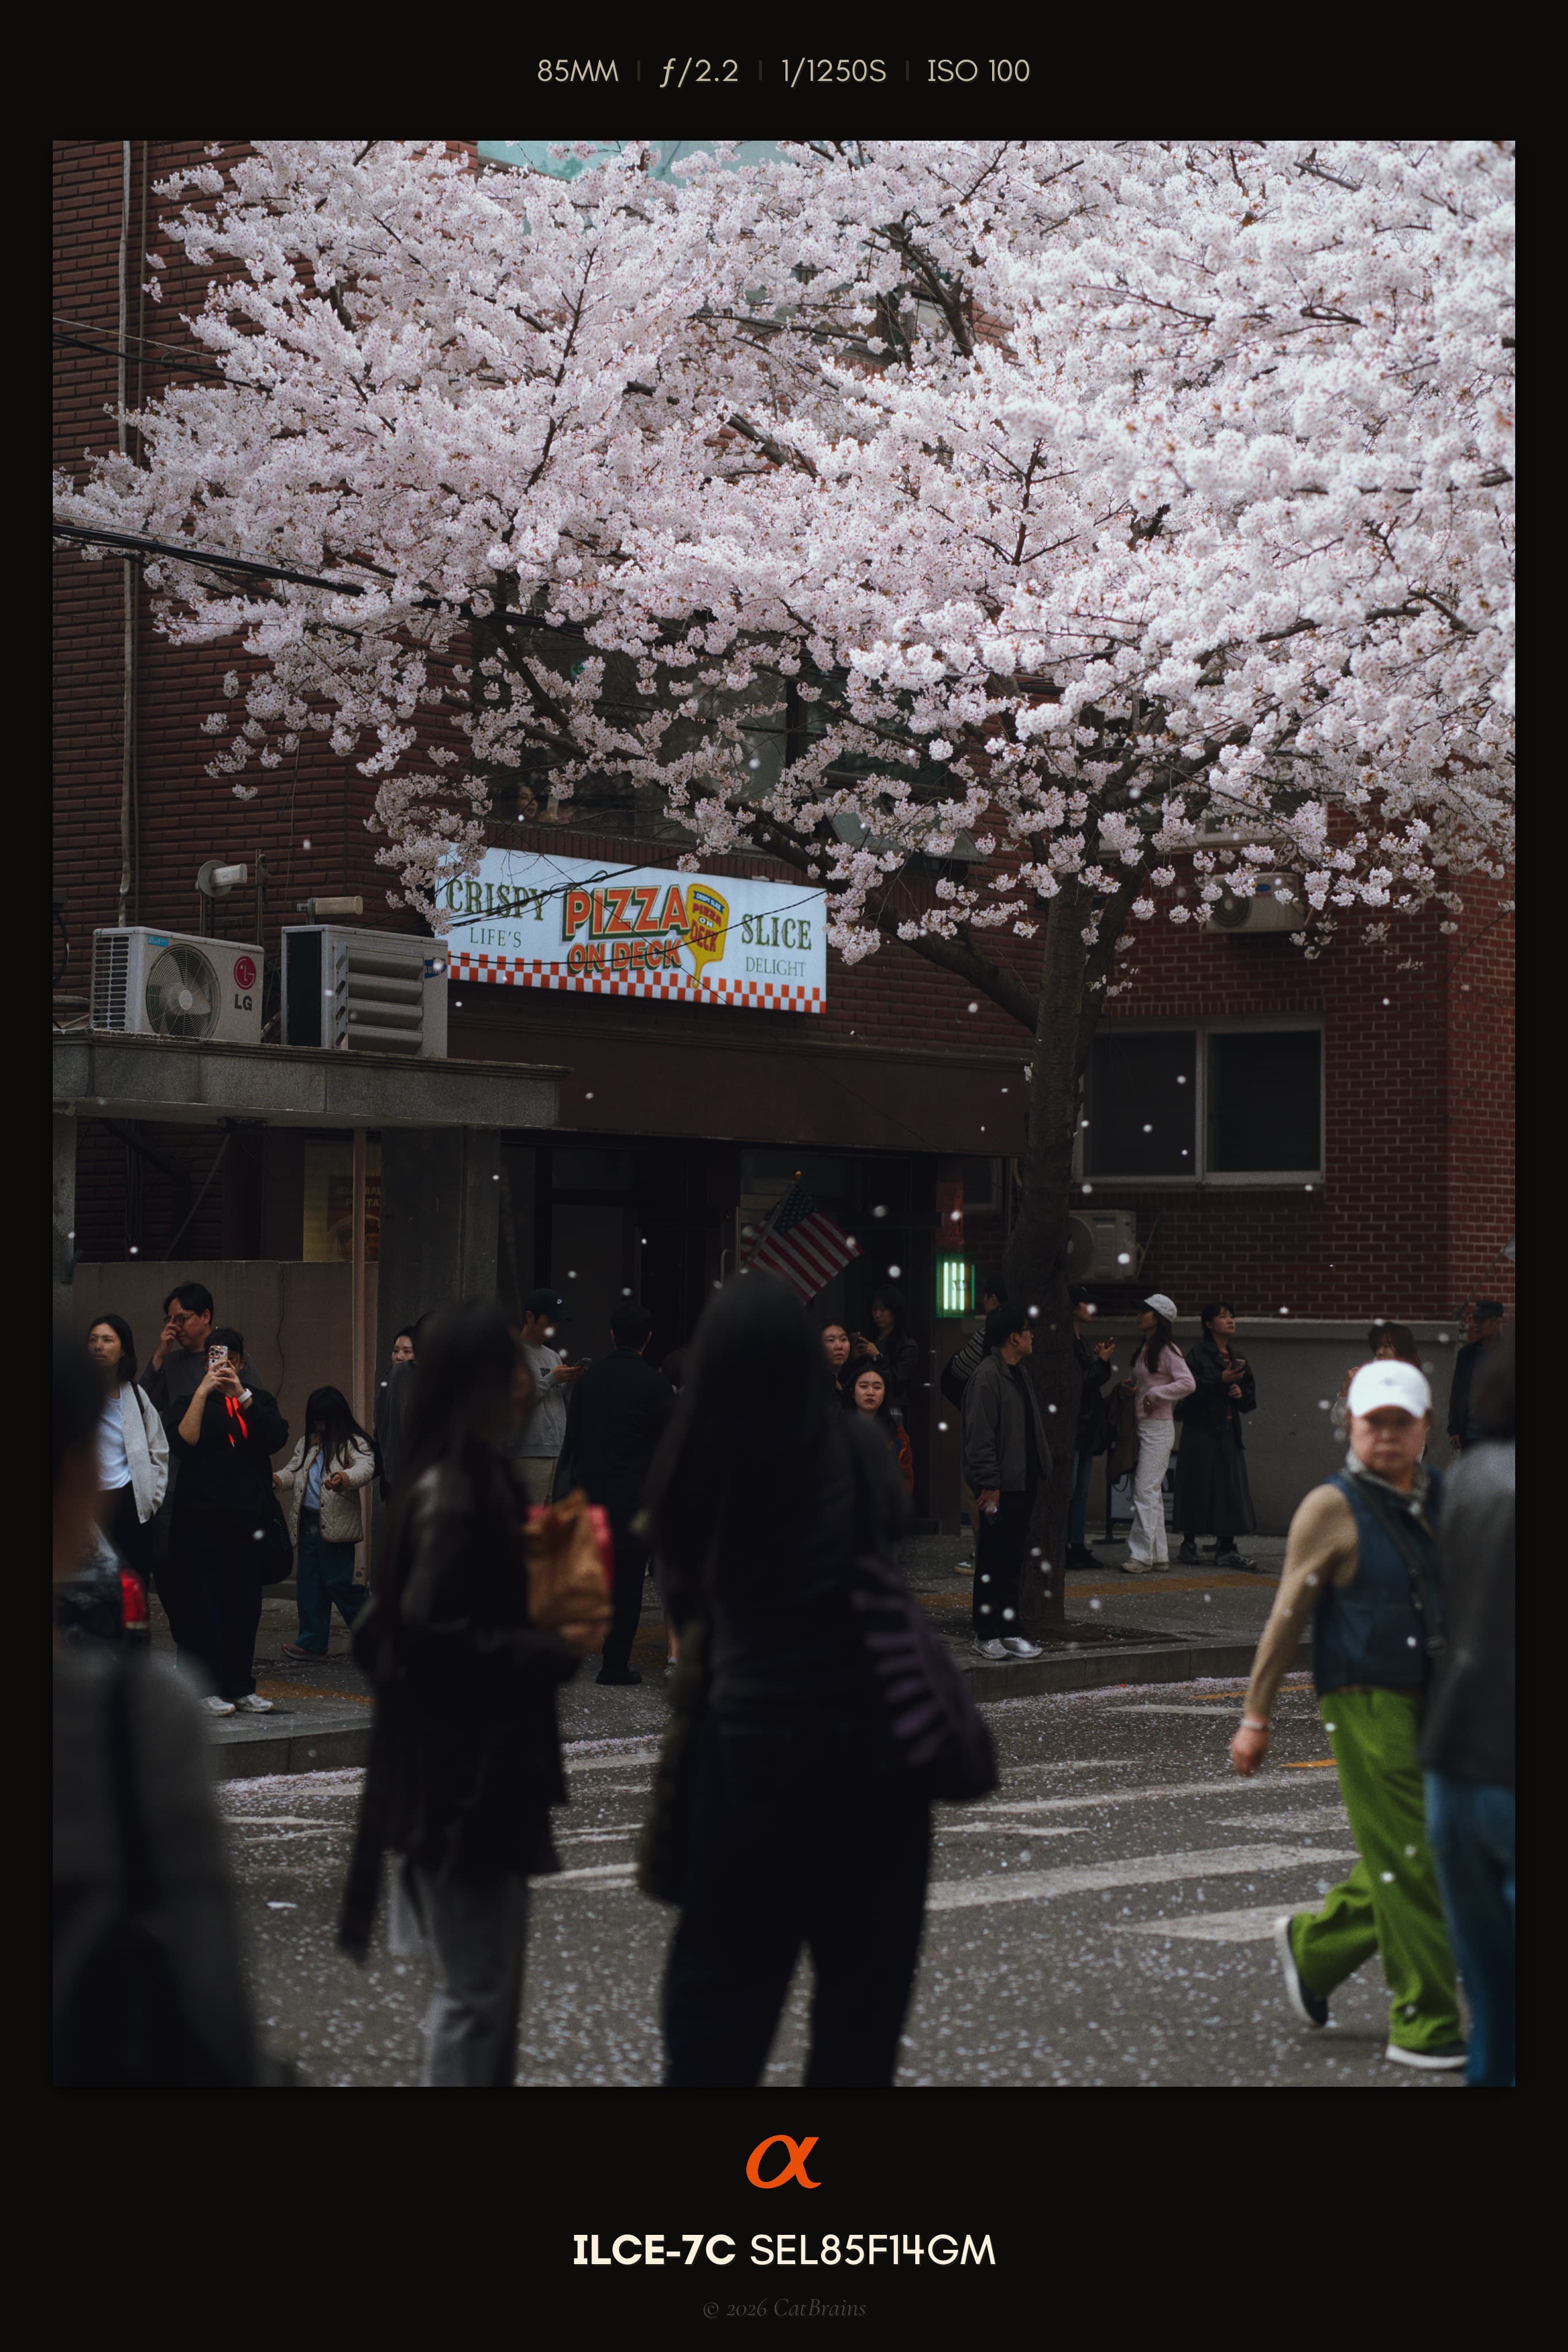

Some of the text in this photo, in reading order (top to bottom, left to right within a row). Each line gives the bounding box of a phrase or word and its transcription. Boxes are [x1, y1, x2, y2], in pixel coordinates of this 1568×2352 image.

[446, 879, 548, 921] CRISPY
[562, 884, 691, 942] PIZZA
[692, 903, 721, 927] PIZZA
[699, 916, 714, 929] ON
[470, 926, 522, 948] LIFE'S
[691, 919, 719, 952] DECK
[741, 913, 812, 951] SLICE
[568, 938, 683, 974] ON DECK
[746, 957, 807, 977] DELIGHT
[234, 993, 253, 1011] LG
